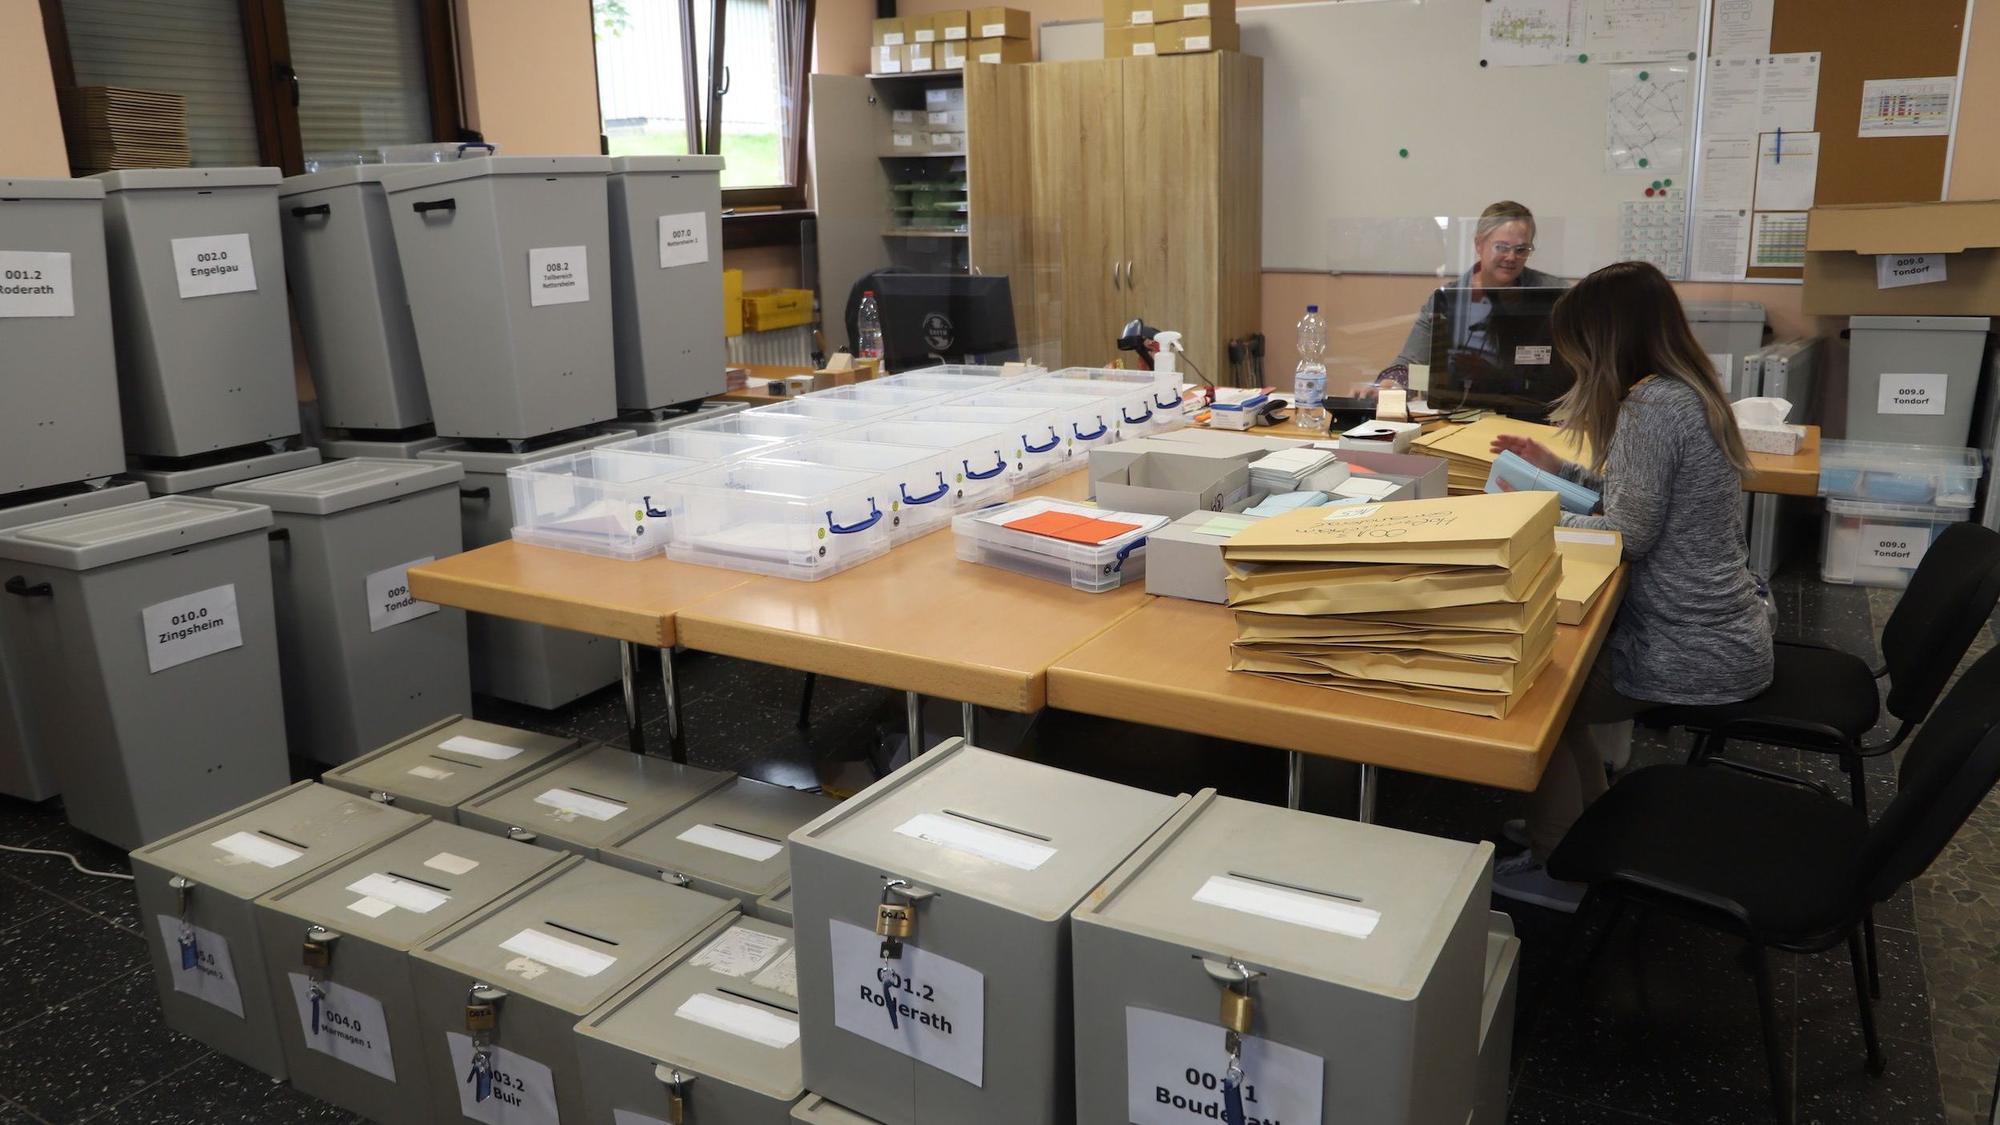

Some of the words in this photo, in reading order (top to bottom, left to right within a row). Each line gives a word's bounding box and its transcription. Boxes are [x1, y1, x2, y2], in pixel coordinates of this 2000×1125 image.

[672, 229, 692, 239] 007.0
[197, 251, 227, 262] 002.0
[1897, 257, 1924, 267] 009.0
[190, 264, 239, 277] Engelgau
[546, 262, 569, 272] 008.2
[1893, 265, 1930, 276] Tondorf
[5, 270, 42, 280] 001.2
[1899, 388, 1925, 396] 009.0
[1893, 397, 1930, 405] Tondorf
[1880, 541, 1907, 549] 009.0
[1874, 549, 1910, 558] Tondorf
[388, 585, 410, 599] 009.
[384, 596, 417, 613] Tondo
[171, 607, 208, 626] 010.0
[158, 617, 224, 645] Zingsheim
[326, 1010, 362, 1032] 004.0
[366, 1040, 372, 1049] 1
[493, 1070, 525, 1093] 03.2
[1185, 1067, 1259, 1104] 001
[493, 1086, 523, 1107] Buir
[1155, 1086, 1281, 1125] Boudea
